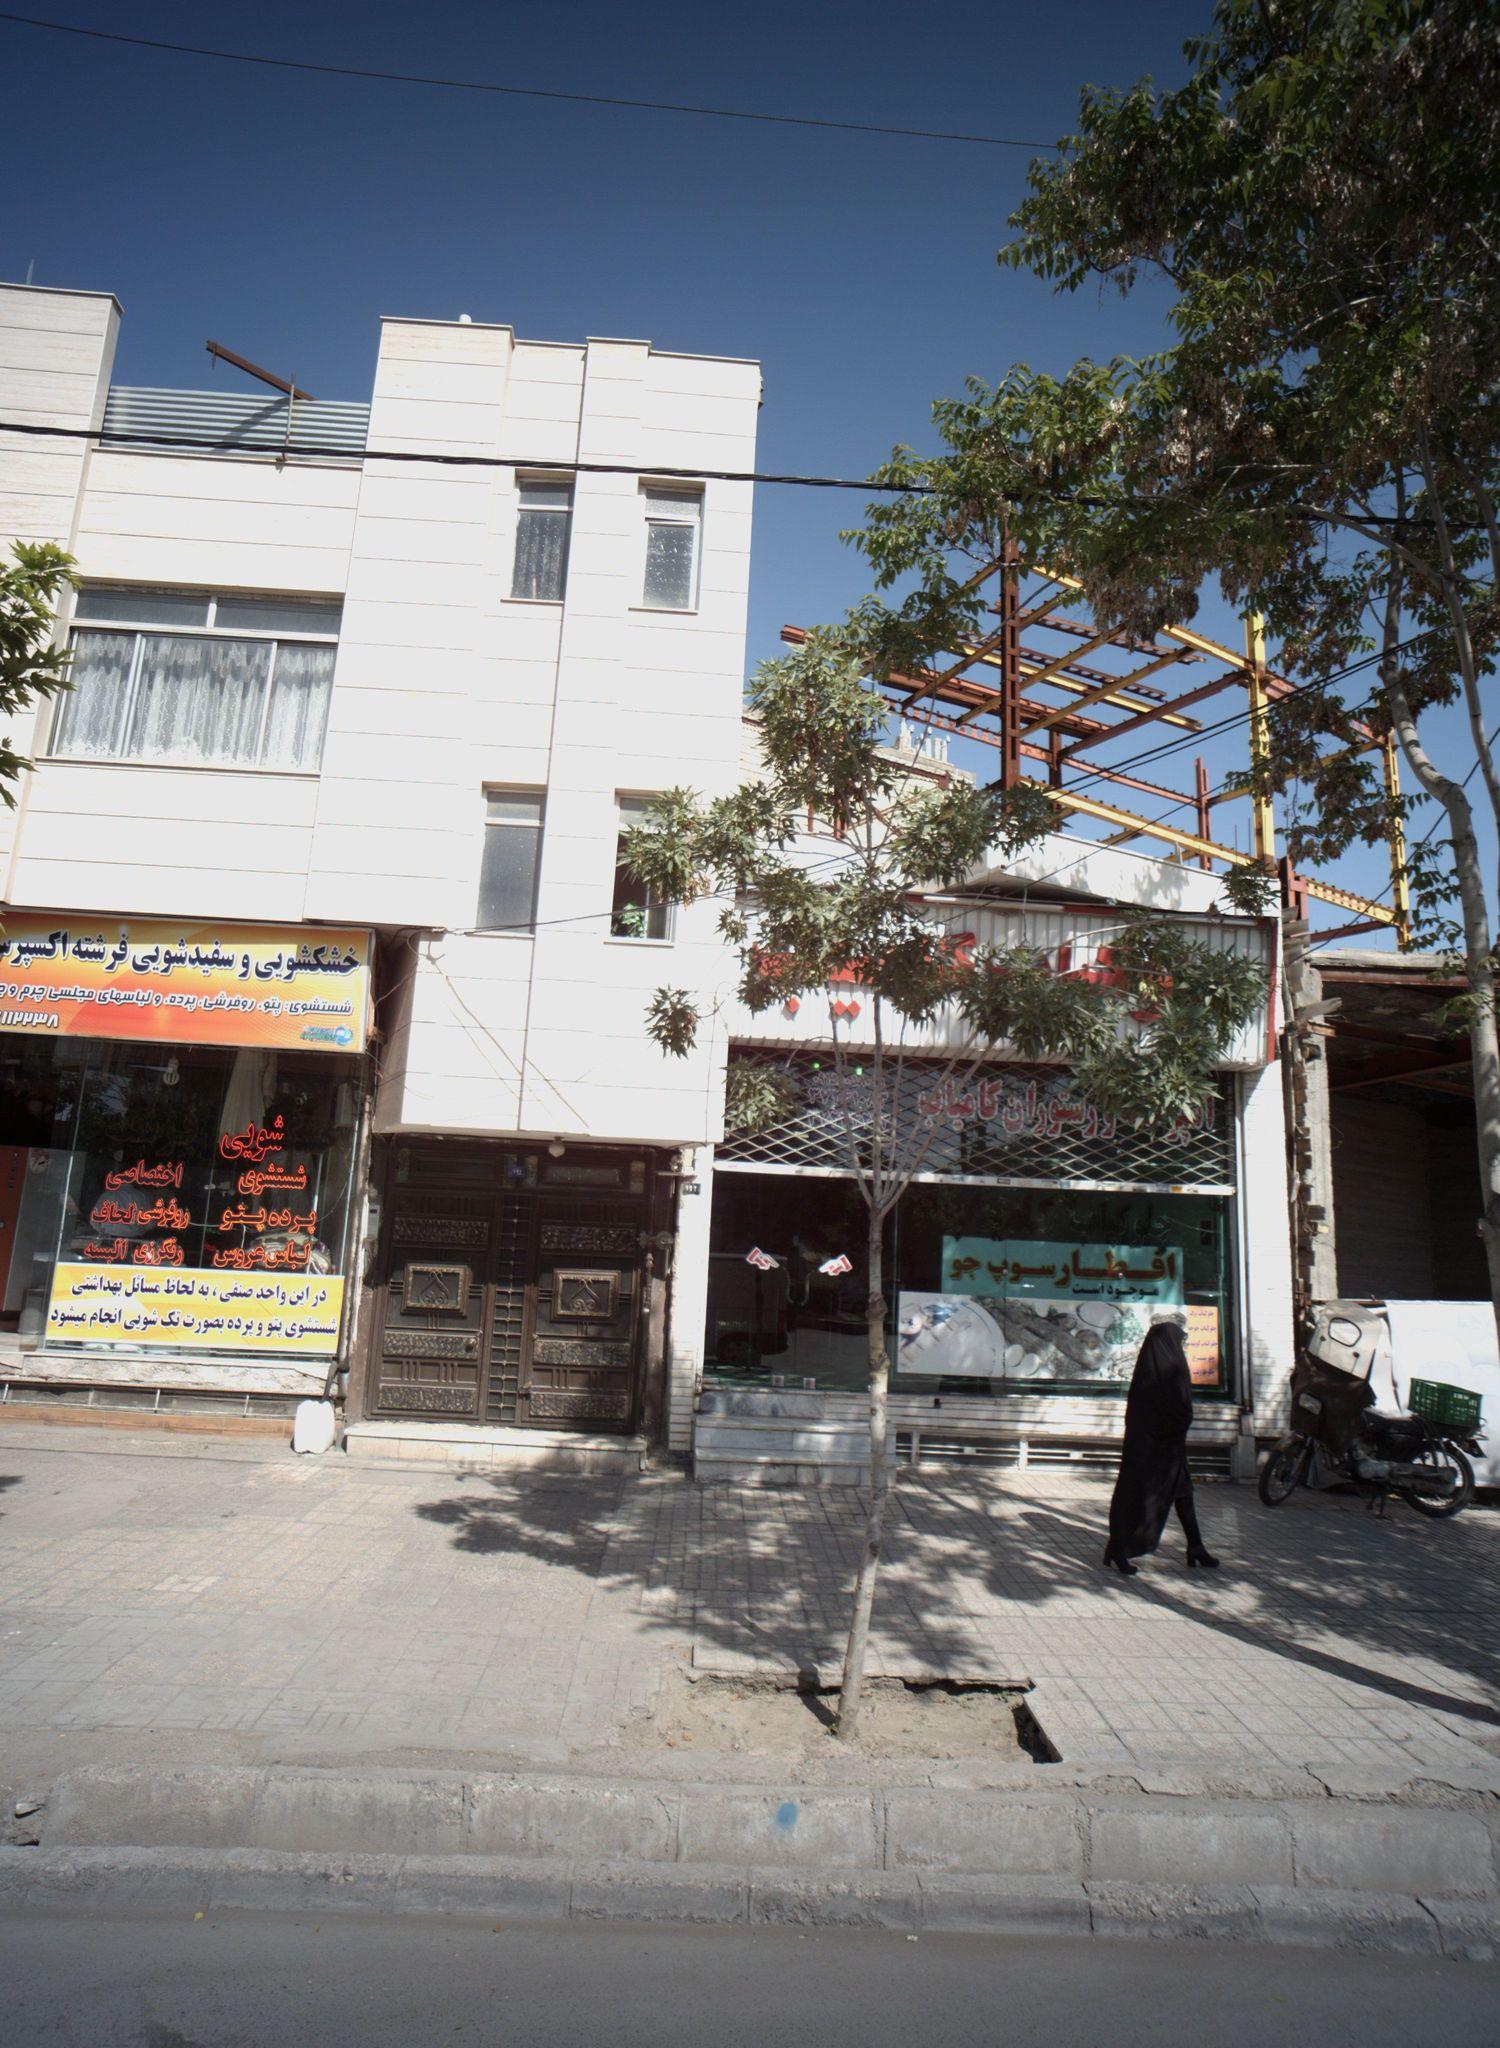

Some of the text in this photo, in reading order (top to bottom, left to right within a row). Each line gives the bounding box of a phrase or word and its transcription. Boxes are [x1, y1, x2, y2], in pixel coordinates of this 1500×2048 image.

[71, 933, 129, 973] فرشته
[131, 938, 235, 976] سفیدشویی
[255, 944, 361, 982] خشکشویی
[238, 953, 250, 978] و
[8, 985, 17, 997] و
[18, 984, 46, 1002] چرم
[48, 986, 96, 1002] مجلسی
[97, 989, 151, 1006] لباسهای
[153, 993, 161, 1006] و
[0, 1010, 58, 1028] ۱۱۲۲۳۸
[1002, 1080, 1098, 1138] رستوران
[105, 1160, 184, 1191] اختصاصی
[237, 1163, 307, 1195] شستشوی
[91, 1198, 191, 1229] روفرشی لحاف
[219, 1203, 317, 1234] پرده پتو
[213, 1240, 311, 1269] لباس عروس
[949, 1248, 1176, 1287] افطار سوپ جو
[71, 1273, 122, 1297] بهداشتی
[124, 1274, 161, 1298] مسائل
[164, 1276, 196, 1298] لحاظ
[197, 1284, 210, 1298] به
[256, 1284, 287, 1305] واحد
[289, 1286, 309, 1306] این
[1072, 1284, 1159, 1300] موجود است
[312, 1288, 326, 1307] در
[50, 1306, 338, 1339] شستشوی پتو و پرده بصورت تک شویی انجام میشود
